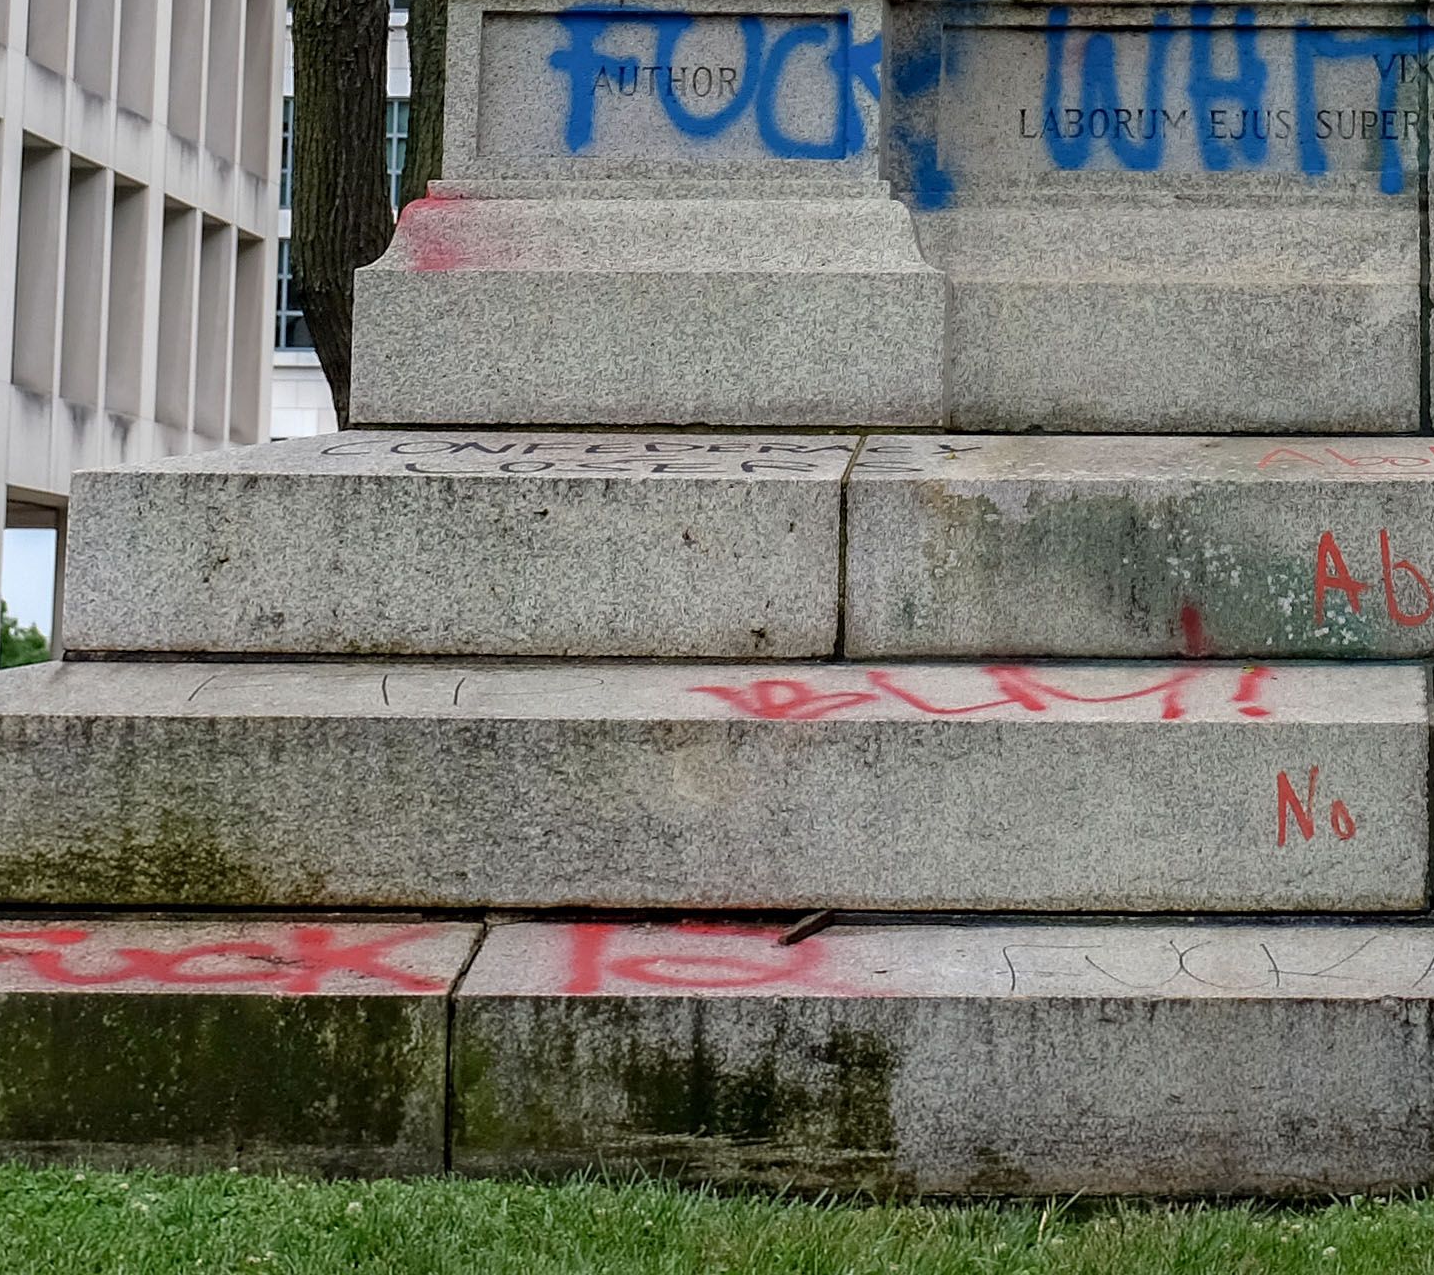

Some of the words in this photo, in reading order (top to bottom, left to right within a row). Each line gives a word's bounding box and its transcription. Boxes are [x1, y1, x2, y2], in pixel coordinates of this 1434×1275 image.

[591, 66, 738, 99] AUTHOR
[1019, 108, 1190, 141] LABORUM
[1210, 108, 1292, 141] EJUS
[321, 437, 985, 457] CONFEDERACY
[402, 460, 926, 474] LOSERS
[1273, 764, 1356, 849] No
[996, 935, 1380, 992] FUCK
